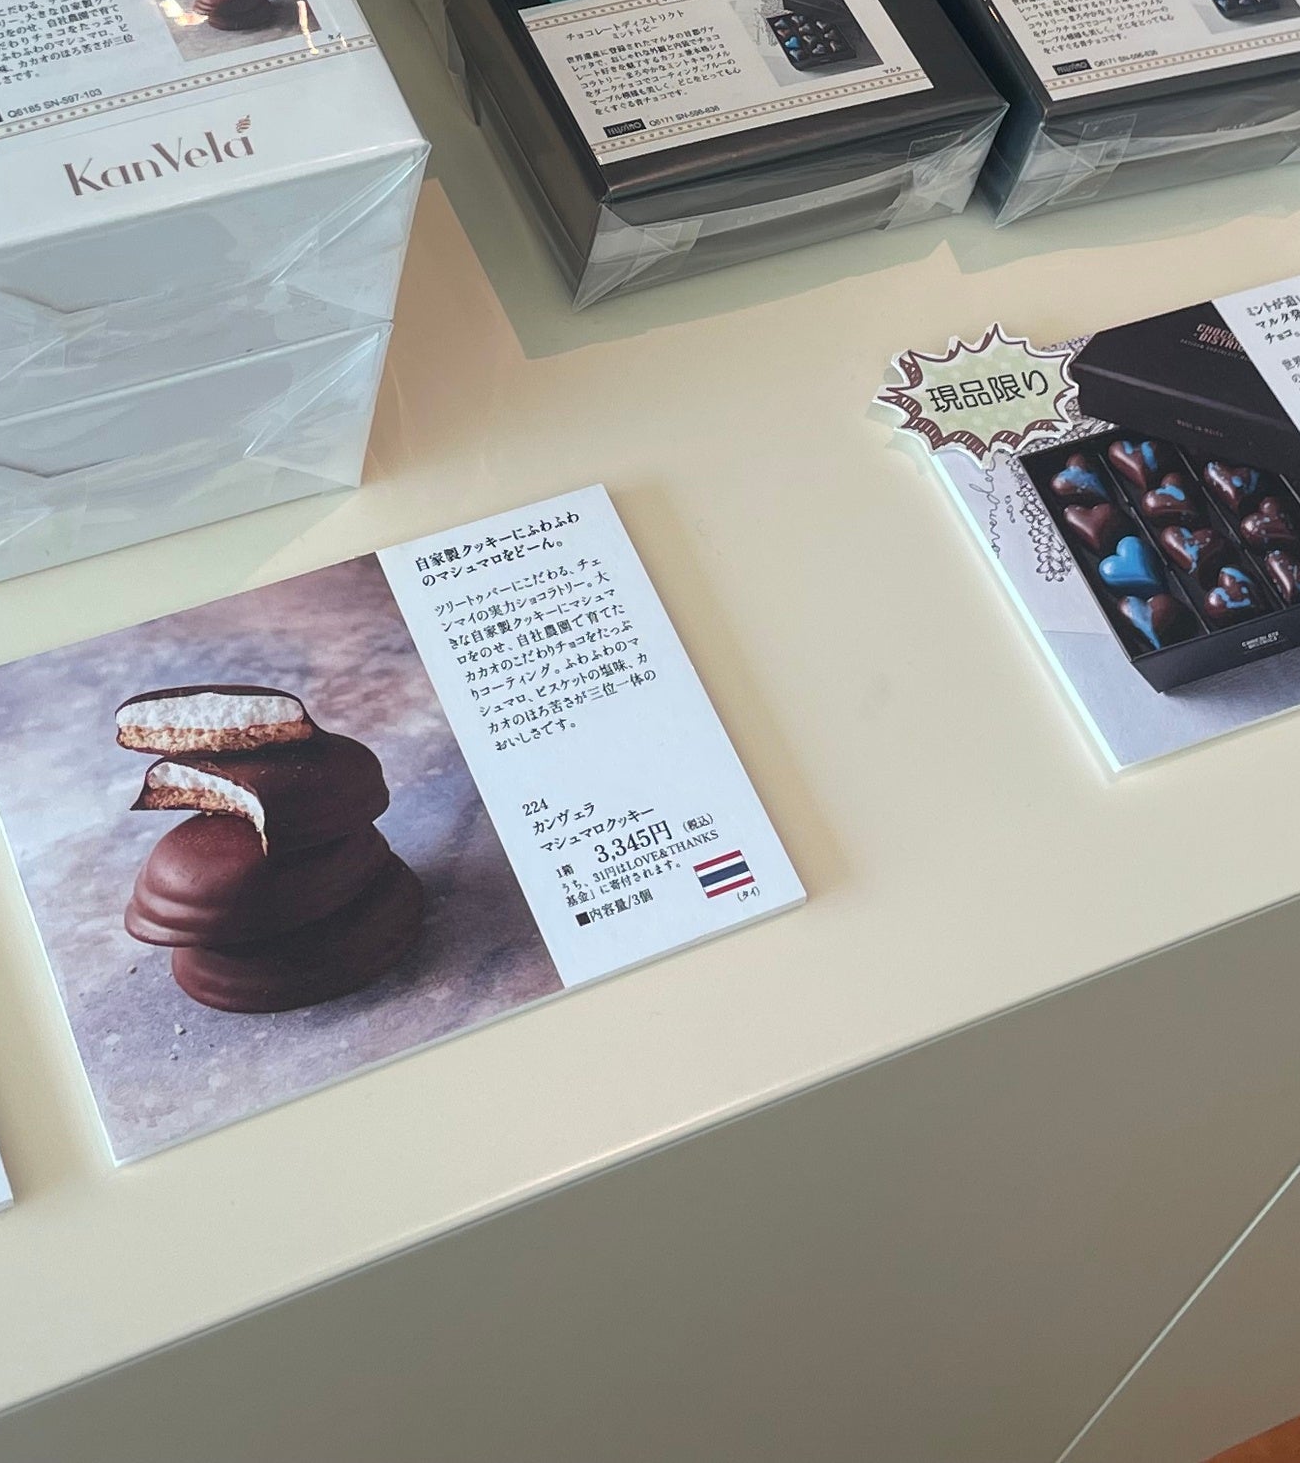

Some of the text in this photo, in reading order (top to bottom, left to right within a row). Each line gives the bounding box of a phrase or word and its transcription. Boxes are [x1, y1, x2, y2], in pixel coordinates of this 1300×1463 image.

[565, 9, 685, 42] チョコレートディストリクト
[62, 128, 255, 198] KanVela
[1264, 328, 1300, 345] チョコ。
[925, 368, 1049, 414] 現品限り
[415, 511, 580, 573] 自家製クッキーにふわふわ
[422, 537, 563, 587] のマシュマロをどーん。
[434, 558, 602, 618] ツリートゥバーにこだわる、チェ
[441, 570, 611, 633] ンマイの実力ショコラトリー。大
[448, 588, 615, 650] きな自家製クッキーにマシュマ
[456, 604, 626, 665] ロをのせ、自社農園で育てた
[465, 620, 634, 684] カカオのこだわりチョコをたっぷ
[470, 637, 639, 701] りコーティング。ふわふわのマ
[479, 652, 648, 718] シュマロ、ビスケットの塩味、カ
[488, 669, 657, 735] カオのほろ苦さが三位一体の
[494, 718, 576, 751] おいしさです。
[521, 798, 549, 817] 224
[532, 802, 595, 836] カンヴェラ
[539, 808, 655, 852] マシュマロクッキー
[555, 812, 714, 879] 1箱 3,345円 (税込)
